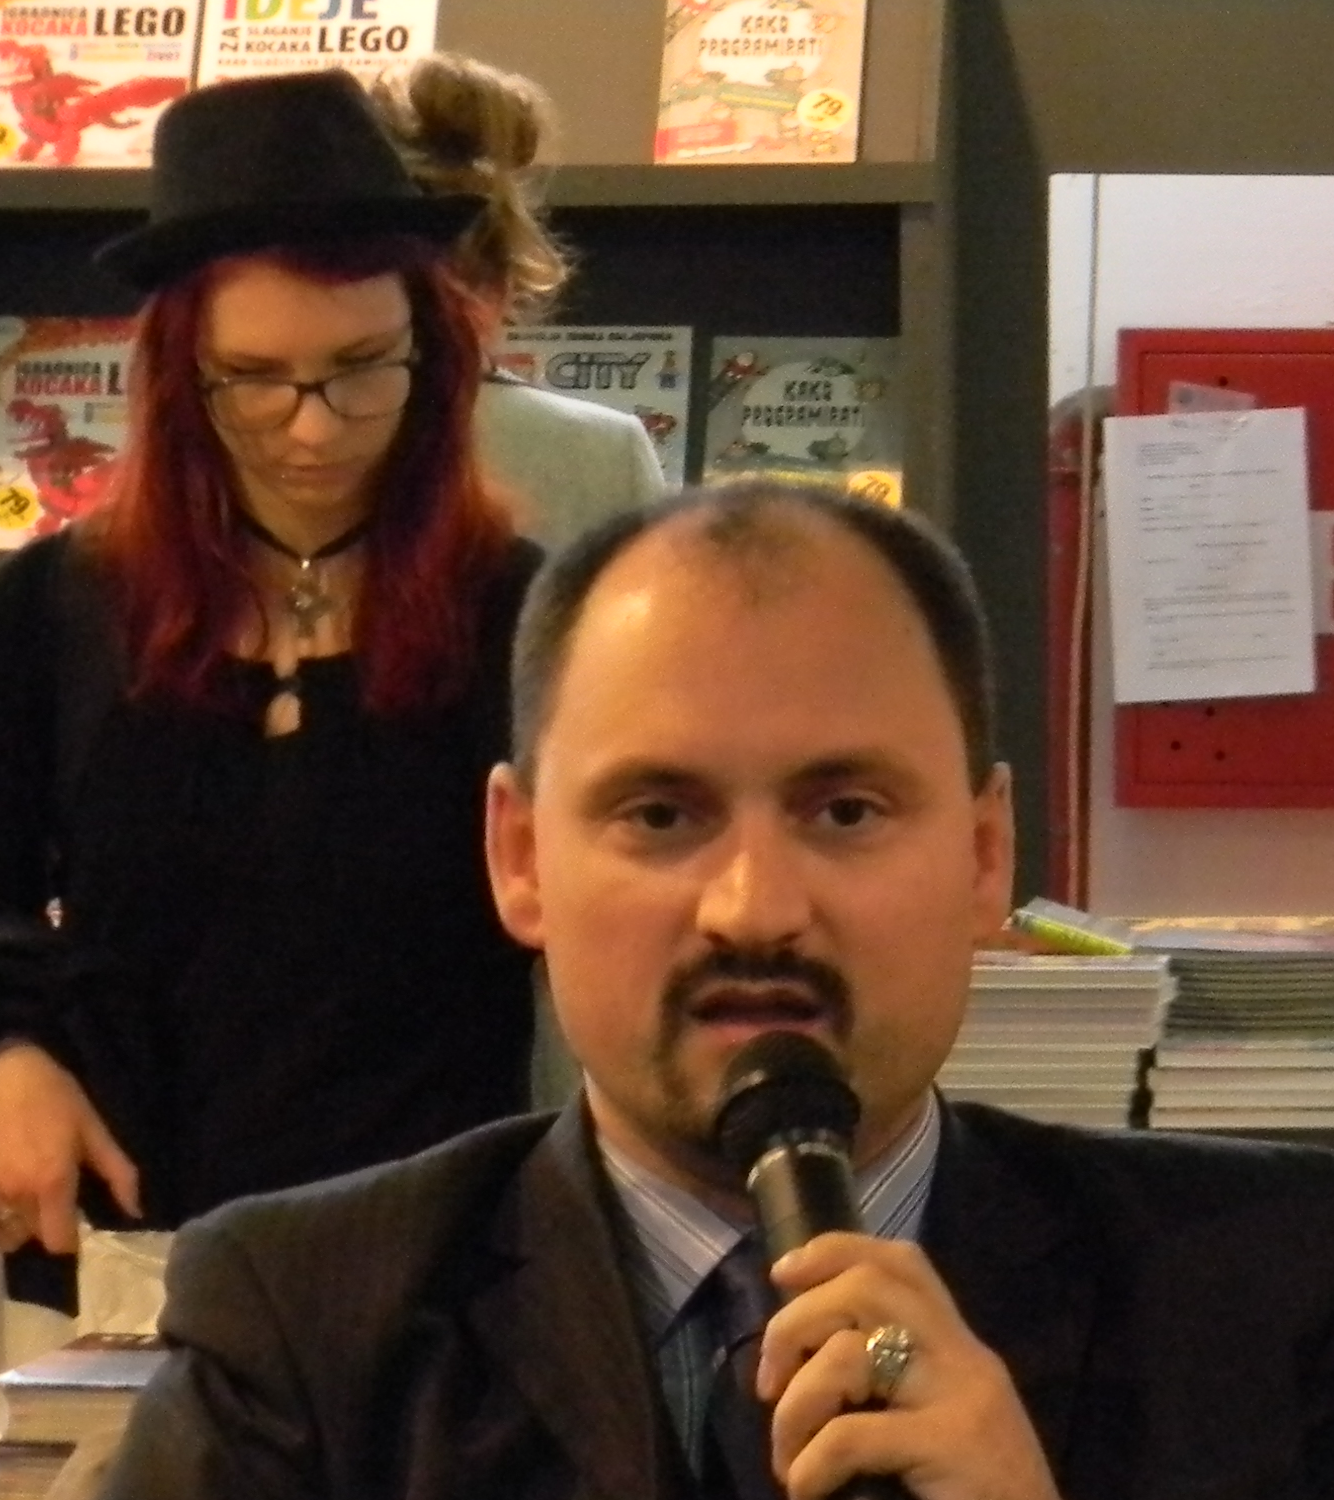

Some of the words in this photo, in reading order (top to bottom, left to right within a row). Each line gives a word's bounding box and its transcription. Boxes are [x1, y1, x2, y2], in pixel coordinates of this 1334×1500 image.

[94, 7, 185, 37] LEGO
[318, 26, 410, 52] LEGO
[812, 92, 845, 117] 79
[0, 486, 31, 516] 79
